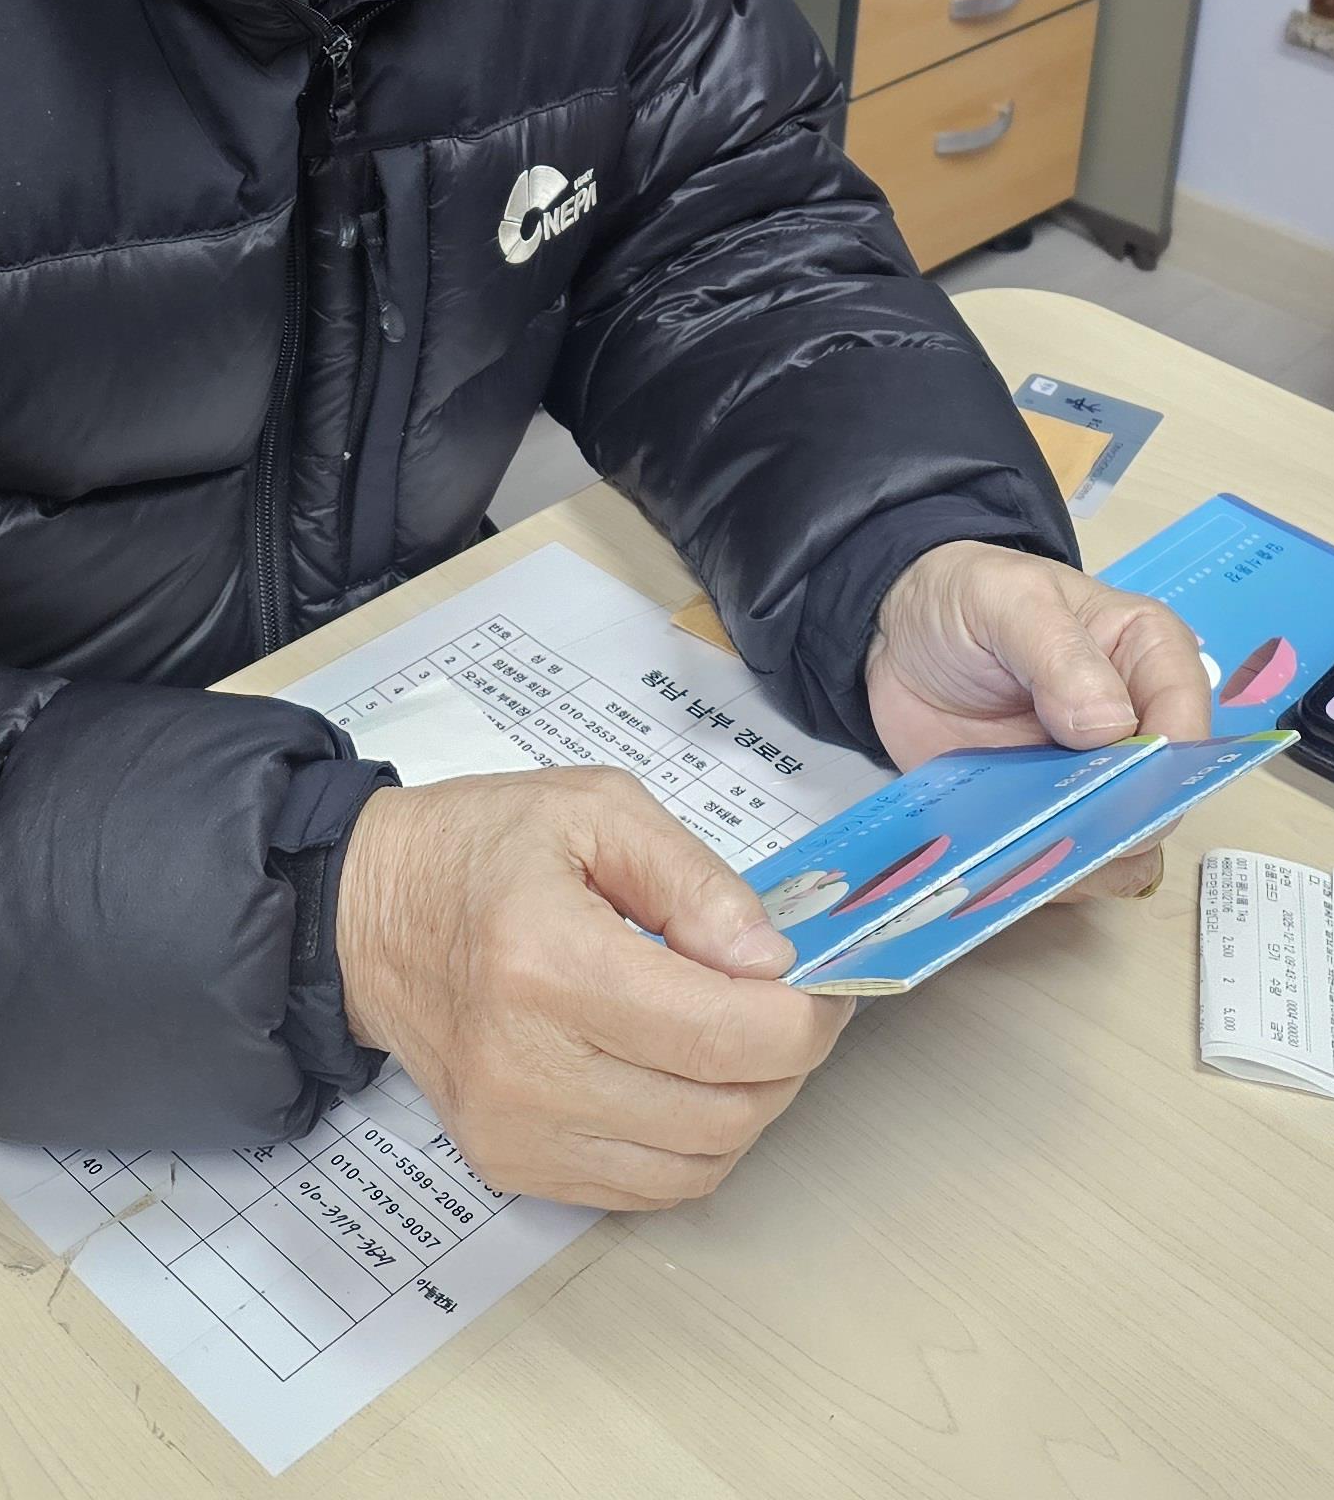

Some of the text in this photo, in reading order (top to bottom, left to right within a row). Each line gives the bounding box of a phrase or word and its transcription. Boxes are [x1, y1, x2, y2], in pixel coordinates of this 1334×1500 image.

[543, 181, 597, 240] NEPA
[419, 671, 430, 679] 3
[393, 687, 404, 695] 4
[444, 656, 456, 665] 2
[498, 693, 532, 717] 부회장
[366, 701, 378, 710] 5
[488, 623, 708, 771] 번호 전화번호 번호
[339, 717, 350, 726] 6
[492, 659, 528, 682] 임창영
[526, 679, 552, 698] 회장
[559, 702, 652, 766] 010-2553-9294
[661, 771, 680, 784] 21
[641, 669, 804, 775] 황남 남부 경로당
[1236, 909, 1248, 922] 1kg
[1268, 943, 1280, 961] 단가
[1223, 977, 1235, 985] 2
[1270, 978, 1282, 997] 수량
[1223, 1007, 1235, 1031] 5,000
[1271, 1021, 1284, 1042] 금액
[82, 1157, 102, 1176] 40
[364, 1129, 474, 1224] 010-5599-2088
[330, 1154, 441, 1248] 010-7979-9037
